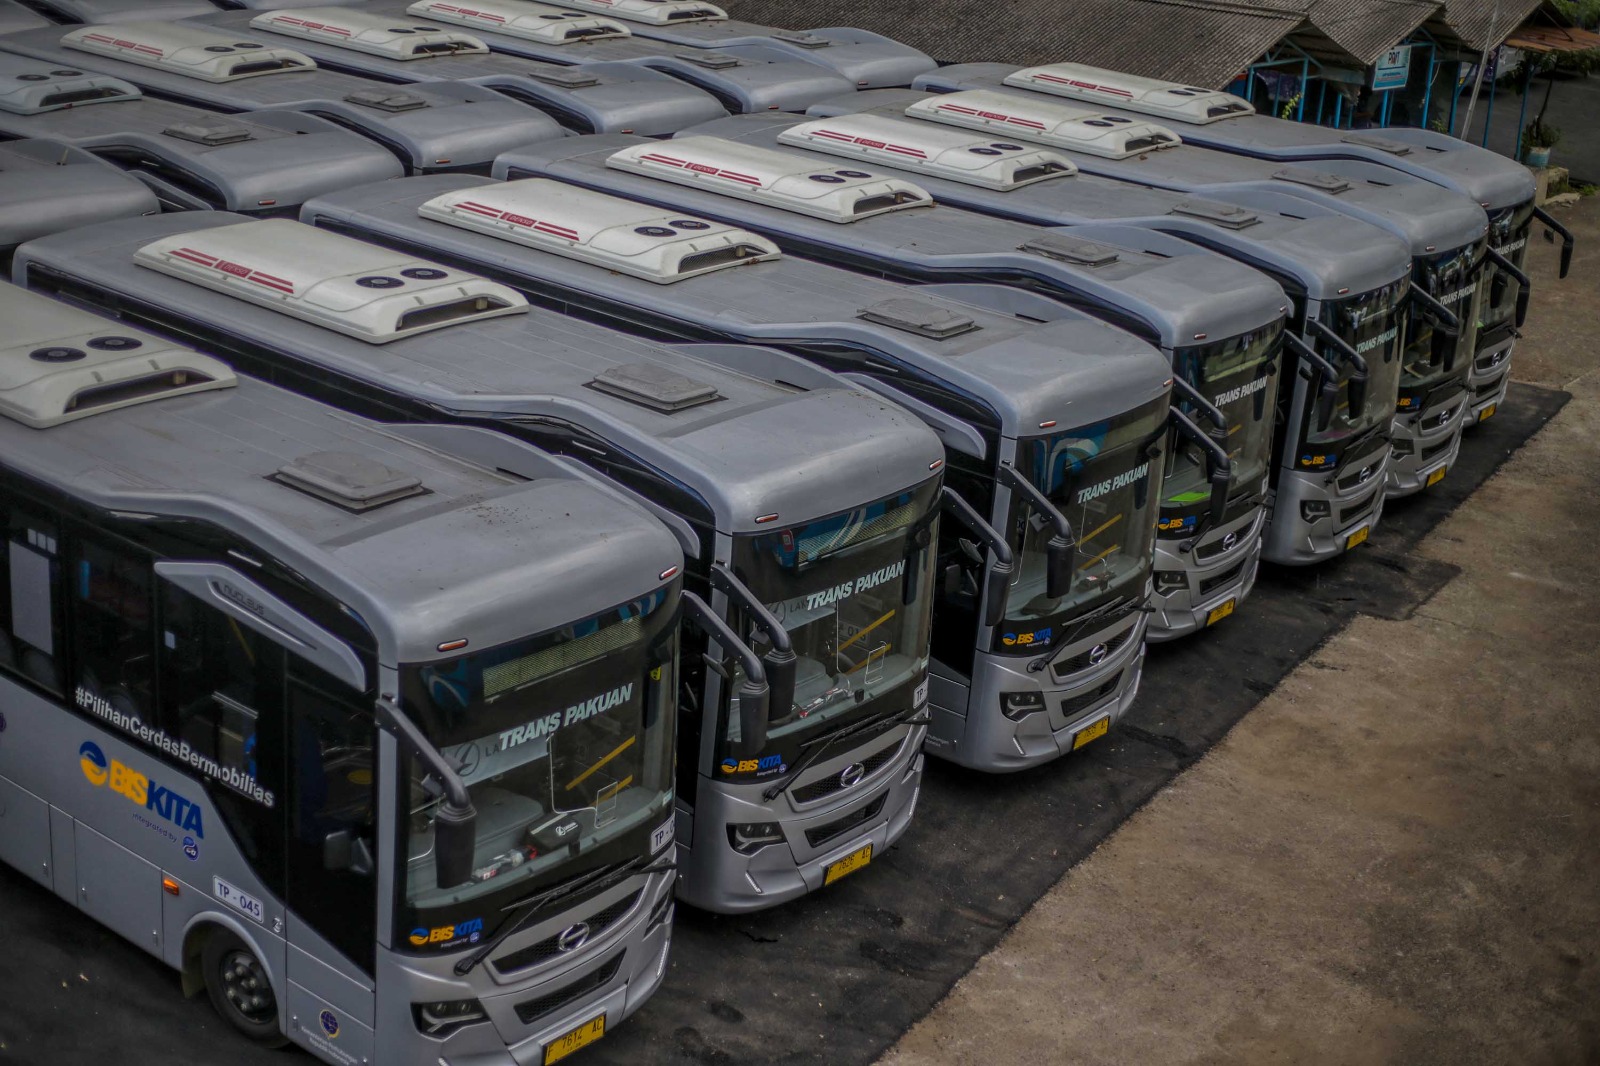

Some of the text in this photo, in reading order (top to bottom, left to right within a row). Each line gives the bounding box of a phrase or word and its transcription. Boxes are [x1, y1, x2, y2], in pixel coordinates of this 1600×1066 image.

[1440, 291, 1458, 306] TRANS
[1356, 337, 1377, 354] TRANS
[1215, 375, 1268, 407] TRANS PAKUAN
[1077, 461, 1149, 504] TRANS PAKUAN
[807, 560, 905, 610] TRANS PAKUAN
[499, 682, 633, 750] TRANS PAKUAN
[737, 754, 782, 772] BISKITA
[109, 758, 204, 839] BISKITA
[132, 812, 168, 837] integrated
[655, 830, 664, 847] TP
[218, 882, 230, 898] TP
[240, 895, 260, 916] 045
[592, 1018, 603, 1033] AC
